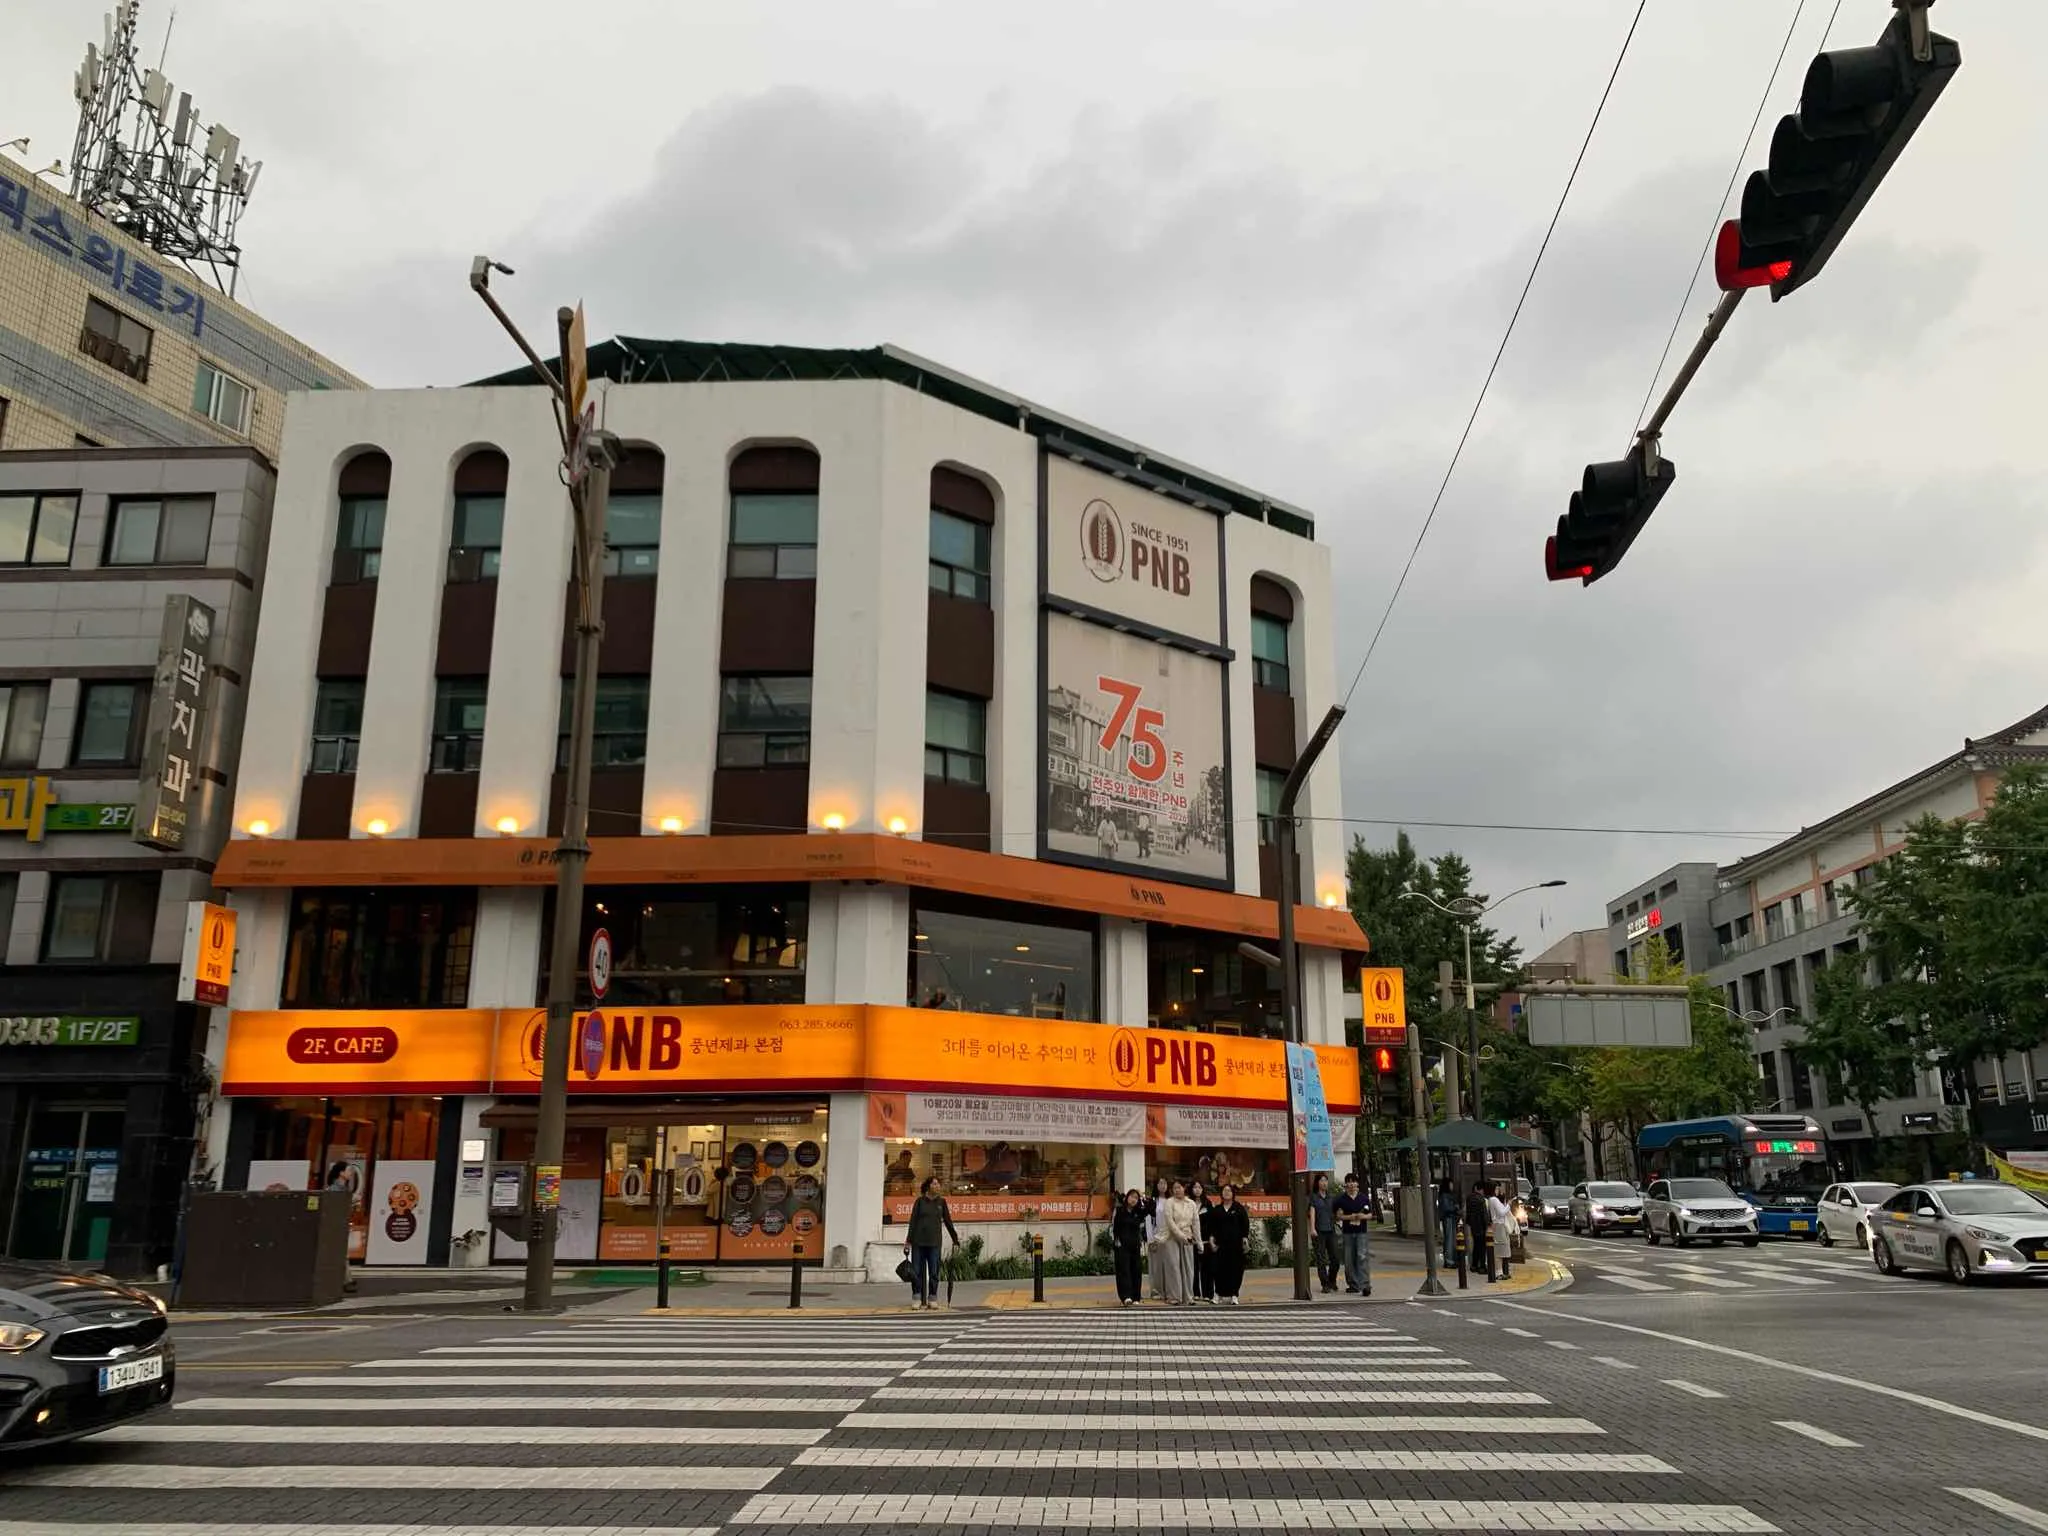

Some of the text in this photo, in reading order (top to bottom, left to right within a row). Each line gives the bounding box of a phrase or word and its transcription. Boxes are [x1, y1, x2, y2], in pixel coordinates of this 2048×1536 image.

[1131, 522, 1189, 552] SINCE 1951
[1131, 539, 1191, 597] PNB
[164, 648, 206, 803] 곽치과
[1098, 676, 1168, 783] 75
[1172, 750, 1185, 789] 주년
[1092, 775, 1188, 809] 전주와 함께한 PNB
[99, 807, 133, 826] 2F/
[1141, 888, 1167, 906] PNB
[1375, 1013, 1396, 1024] PNB
[67, 1021, 131, 1041] 1F/2F
[303, 1037, 385, 1055] 2F. CAFE
[689, 1036, 784, 1055] 풍년제과 본점
[942, 1037, 1097, 1065] 3대를 이어온 추억의 맛
[1146, 1036, 1218, 1087] PNB
[1223, 1058, 1265, 1077] 풍년제과
[923, 1098, 962, 1109] 10월20일
